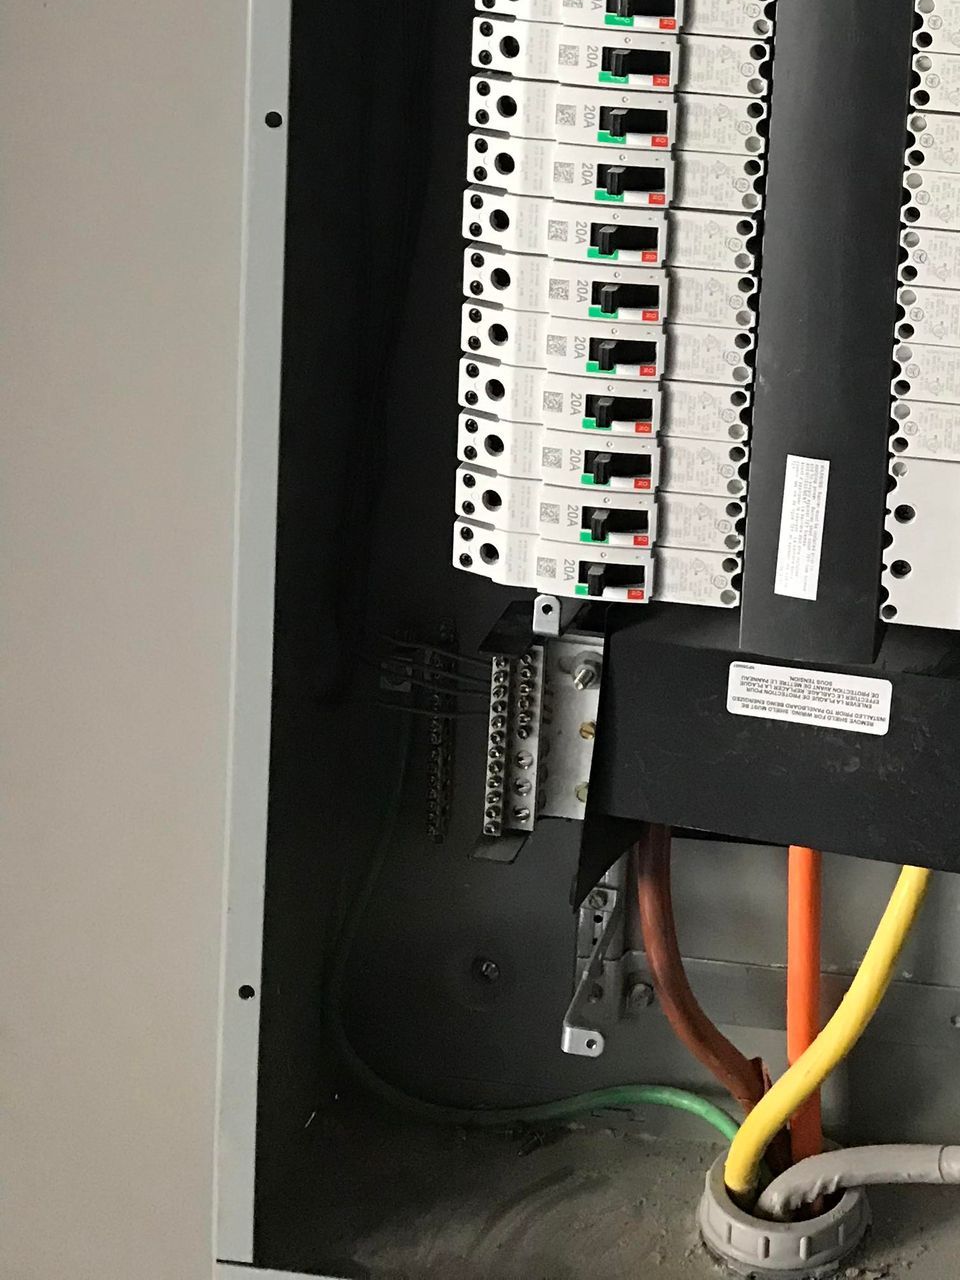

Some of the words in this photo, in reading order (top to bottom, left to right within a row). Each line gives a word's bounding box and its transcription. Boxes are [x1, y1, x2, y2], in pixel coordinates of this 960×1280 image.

[587, 46, 598, 68] 20A
[584, 105, 595, 128] 20A
[582, 163, 593, 185] 20A
[576, 221, 587, 244] 20A
[577, 280, 588, 302] 20A
[575, 336, 586, 359] 20A
[570, 393, 582, 415] 20A
[570, 449, 581, 471] 20A
[568, 505, 579, 527] 20A
[564, 559, 575, 580] 20A
[739, 680, 763, 688] PLAQUE
[741, 675, 768, 683] PANNEAU
[764, 689, 800, 698] PROTECTION
[773, 685, 804, 693] REPLACER
[832, 687, 869, 696] PROTECTION
[812, 695, 835, 703] PLAQUE
[845, 695, 879, 704] EFFECTUER
[845, 700, 871, 708] ENLEVER
[849, 718, 873, 726] REMOVE
[854, 713, 885, 721] INSTALLED
